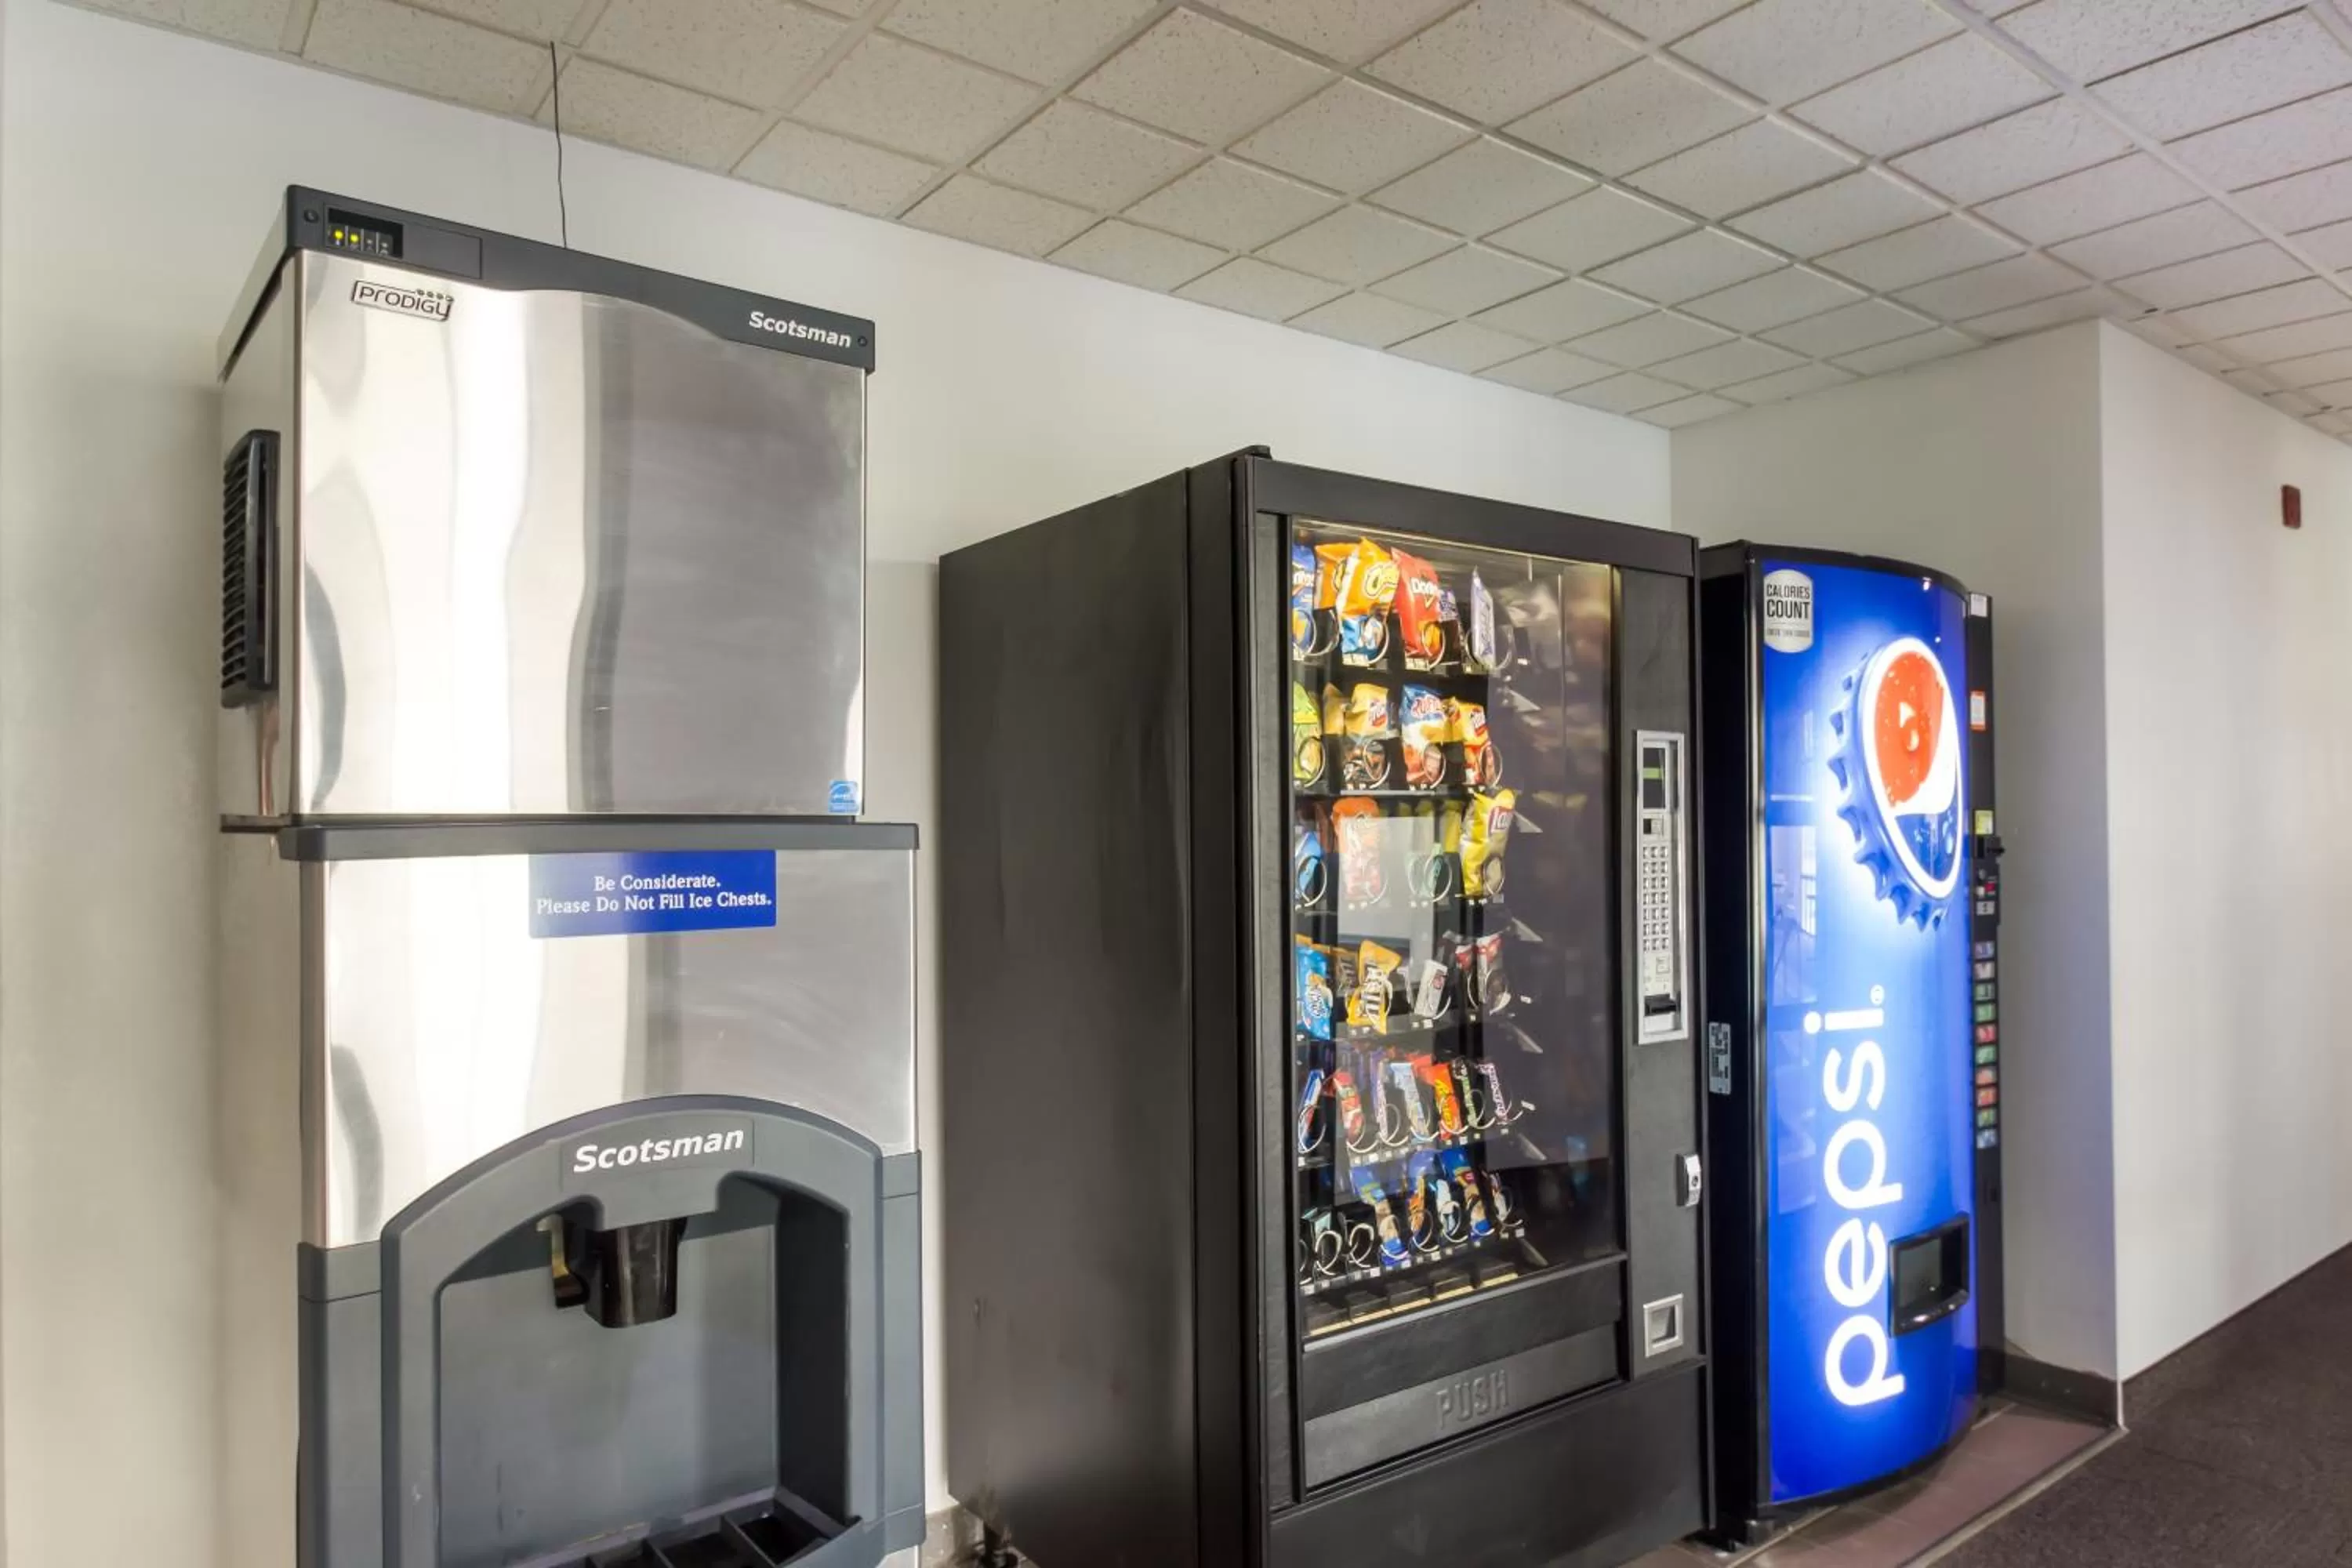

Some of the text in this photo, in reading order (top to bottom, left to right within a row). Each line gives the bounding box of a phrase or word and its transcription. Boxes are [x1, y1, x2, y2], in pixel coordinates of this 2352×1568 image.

[748, 310, 852, 348] Scotsman
[1766, 583, 1810, 600] CALORIES
[1766, 598, 1810, 619] COUNT
[593, 874, 721, 891] Be Considerate.
[535, 891, 772, 915] Please Do Not Fill Ice Chests.
[573, 1129, 744, 1173] Scotsman
[1805, 1008, 1904, 1406] pepsi
[1436, 1370, 1508, 1430] PUSH
